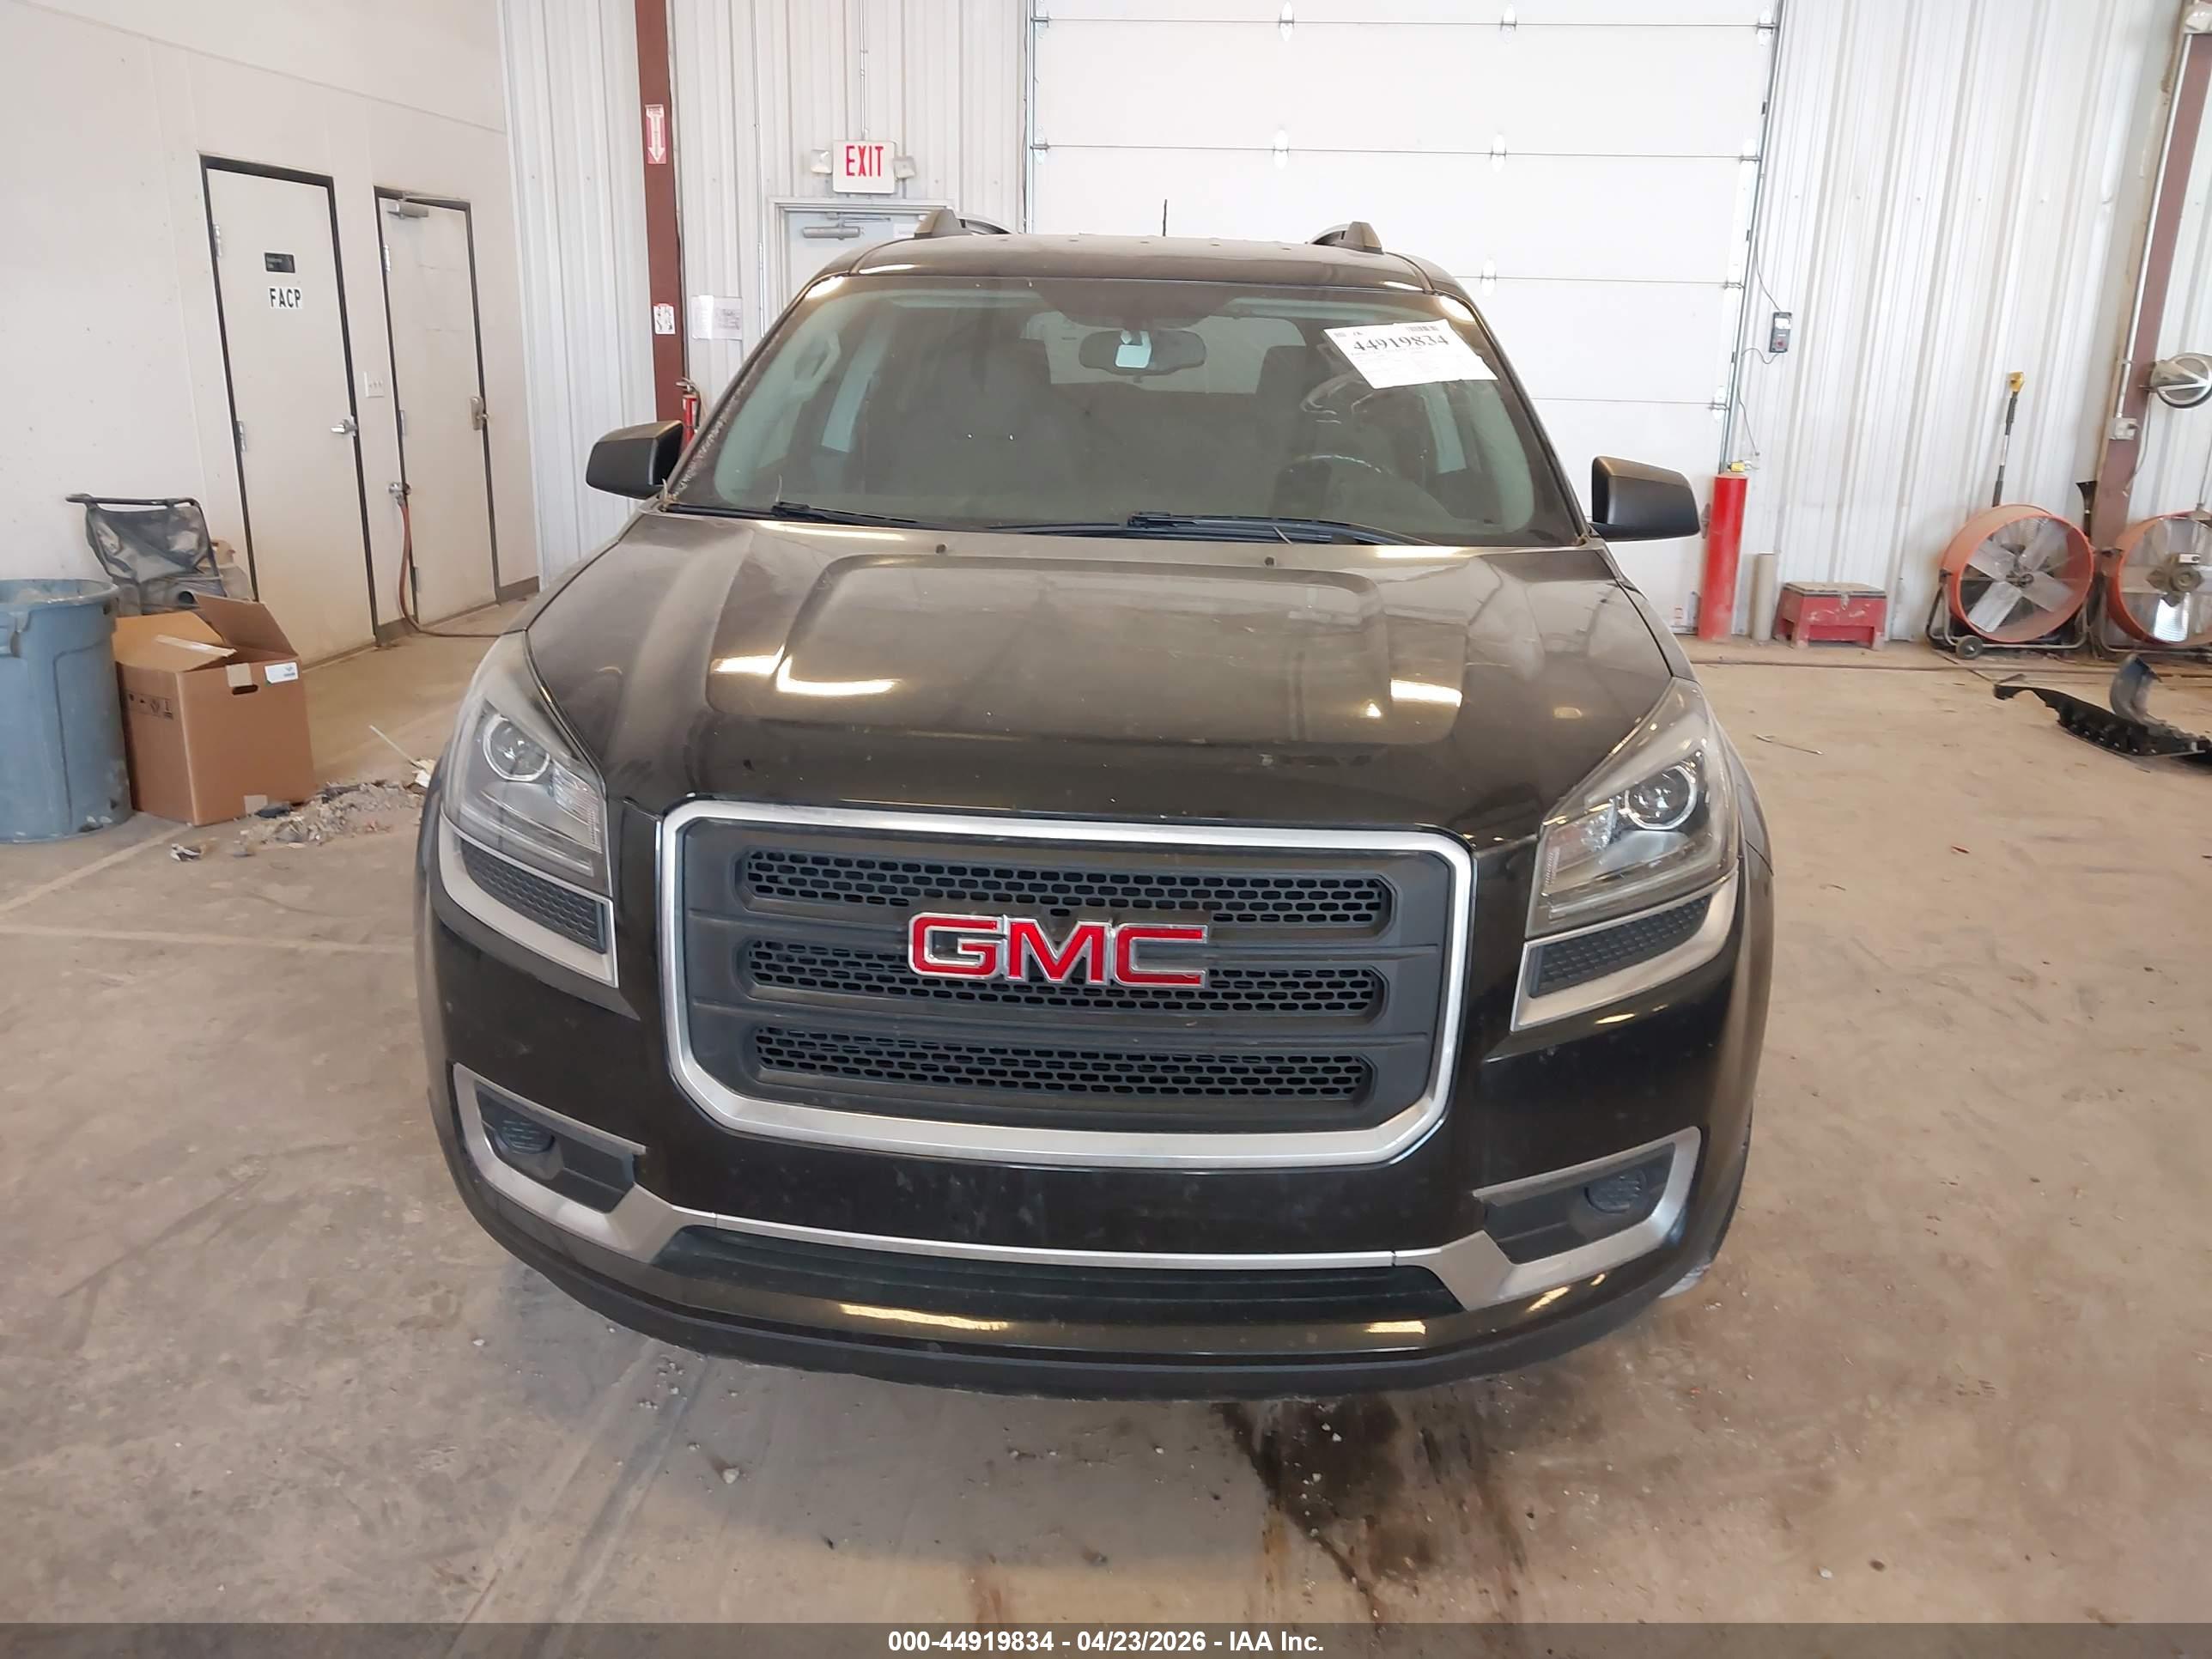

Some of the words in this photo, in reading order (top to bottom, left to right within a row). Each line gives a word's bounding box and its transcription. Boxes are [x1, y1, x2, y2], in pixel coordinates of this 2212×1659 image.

[846, 145, 884, 177] EXIT
[269, 288, 301, 307] FACP
[1353, 335, 1449, 351] 44919834
[908, 913, 1207, 988] GMC
